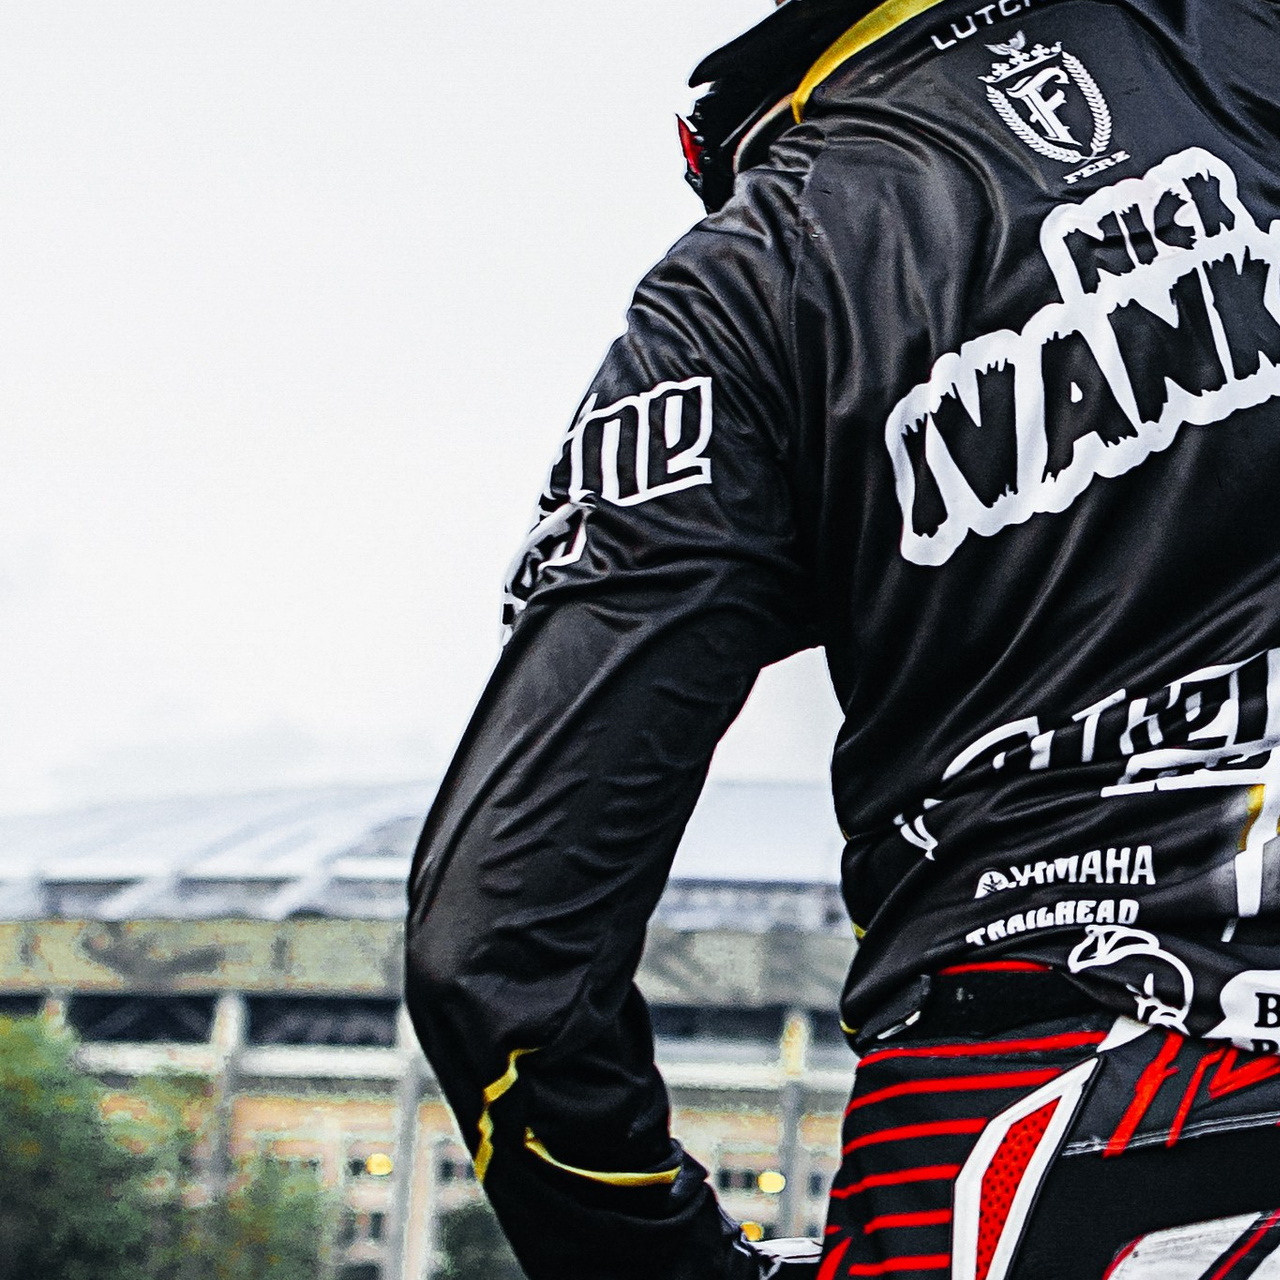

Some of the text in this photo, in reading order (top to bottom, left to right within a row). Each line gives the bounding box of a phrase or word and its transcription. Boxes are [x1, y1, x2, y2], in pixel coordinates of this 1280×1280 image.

[1062, 150, 1131, 184] FERZ
[1060, 166, 1238, 296] NICK
[965, 898, 1140, 946] TRAILHEAD
